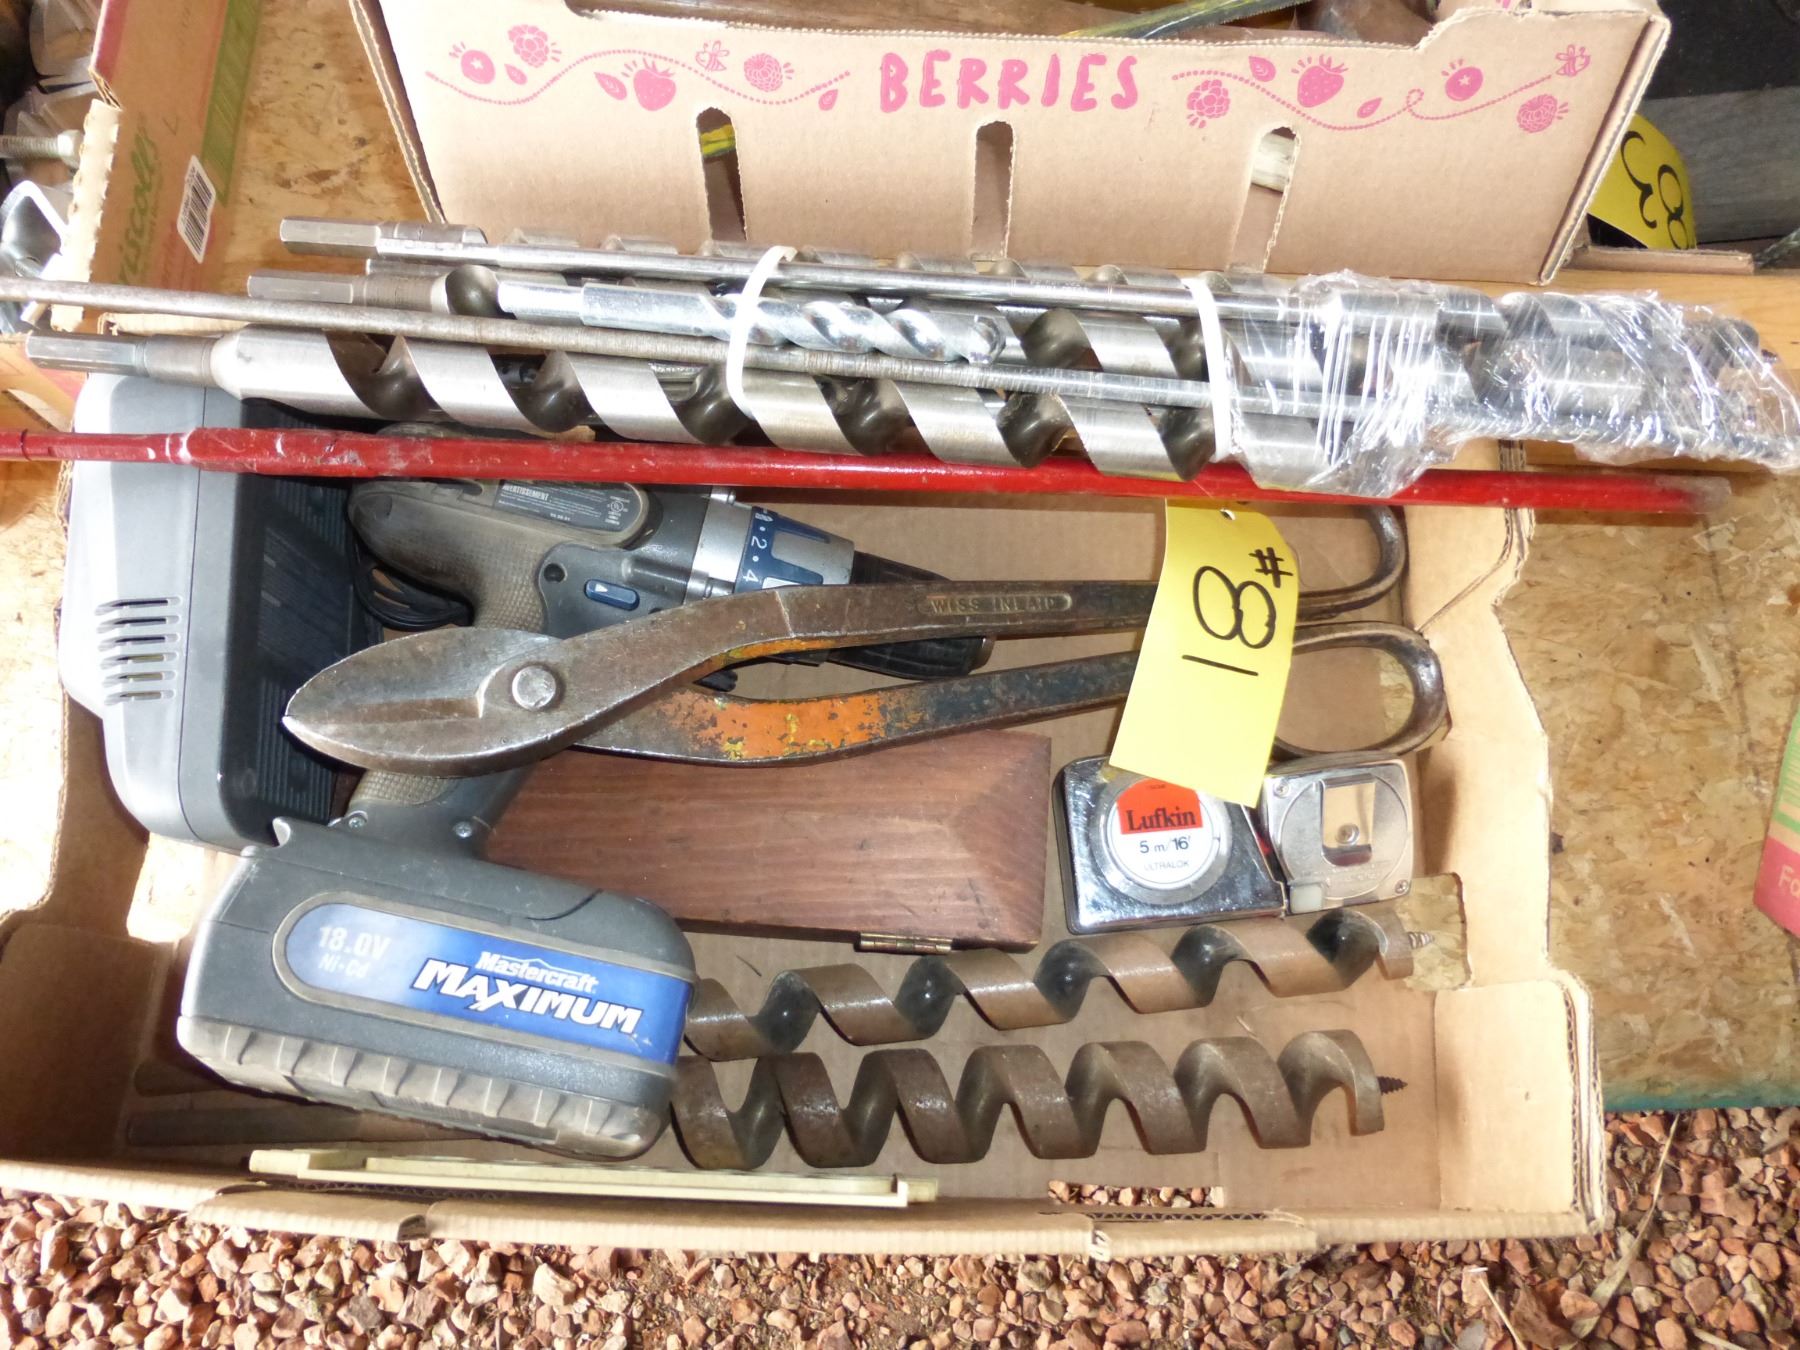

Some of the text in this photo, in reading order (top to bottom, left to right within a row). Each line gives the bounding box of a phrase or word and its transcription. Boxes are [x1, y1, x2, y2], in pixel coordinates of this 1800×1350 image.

[880, 49, 1138, 113] BERRIES
[743, 536, 768, 582] 2 4
[930, 598, 979, 614] WISS
[1126, 806, 1196, 832] Lufkin
[1140, 840, 1149, 854] 5
[319, 926, 392, 960] 18.0V
[475, 951, 599, 993] Mastercraft
[410, 957, 644, 1035] MAXIMUM
